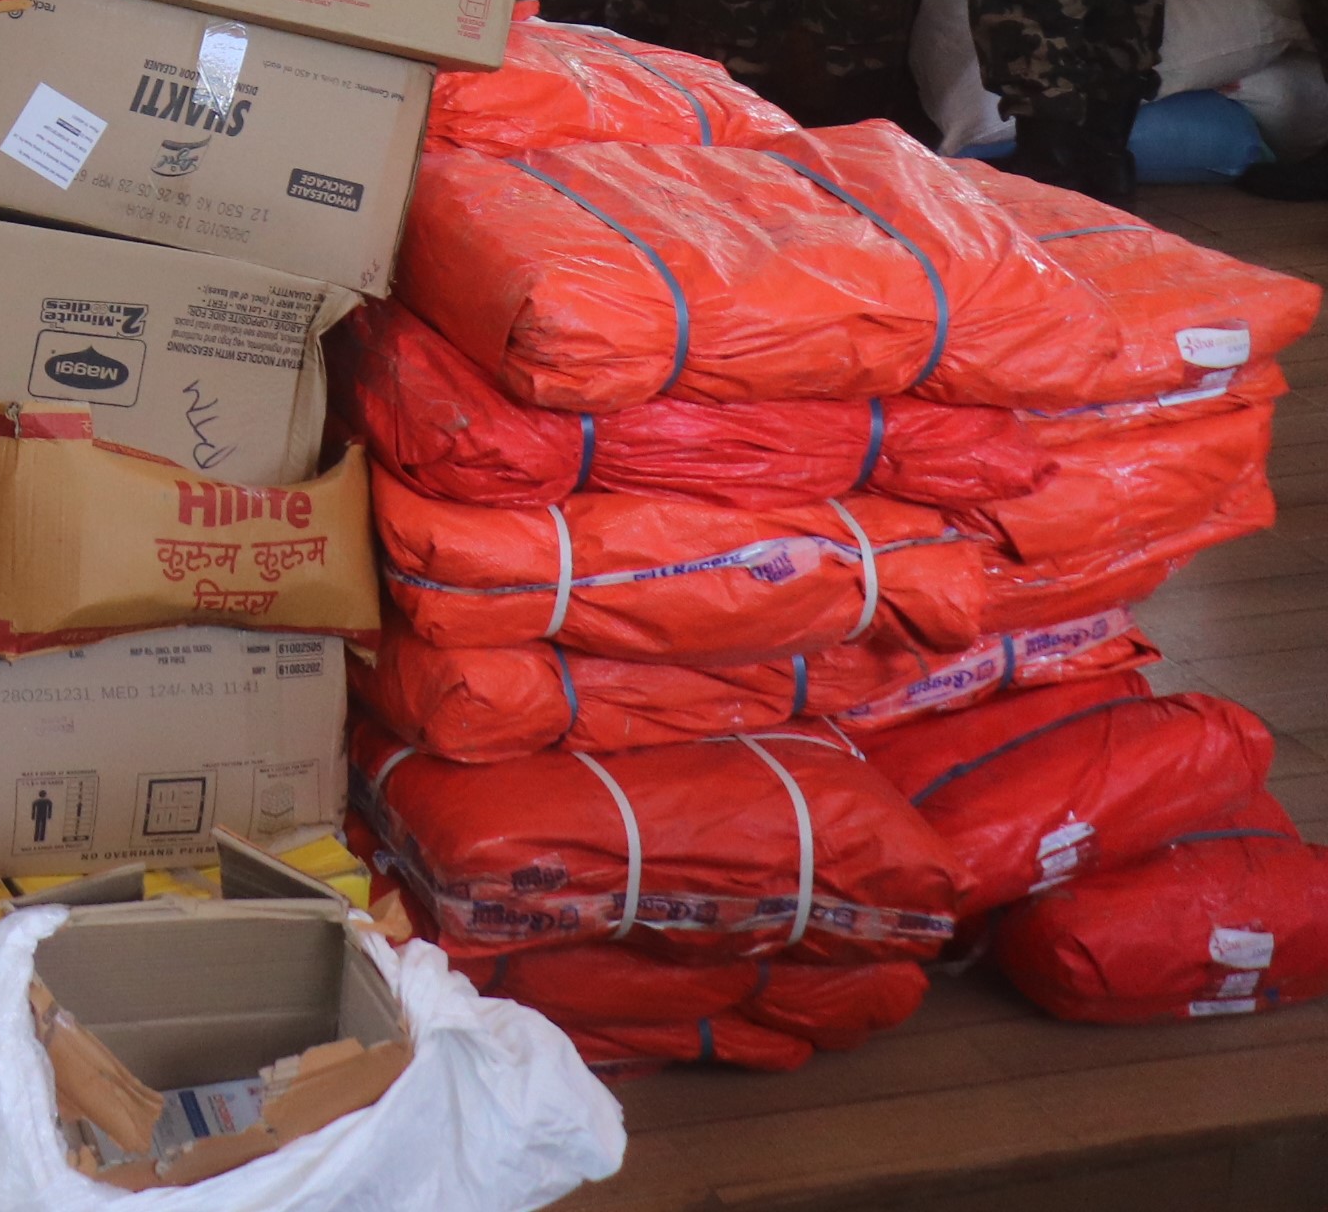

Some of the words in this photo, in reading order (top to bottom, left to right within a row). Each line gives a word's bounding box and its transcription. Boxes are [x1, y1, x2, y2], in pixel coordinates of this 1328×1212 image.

[144, 59, 176, 75] CLEANER
[302, 174, 354, 194] PACKAGE
[288, 184, 357, 208] WHOLESALE
[55, 360, 117, 380] Maggi
[155, 538, 241, 581] कुरुम
[251, 536, 328, 581] कुरुम
